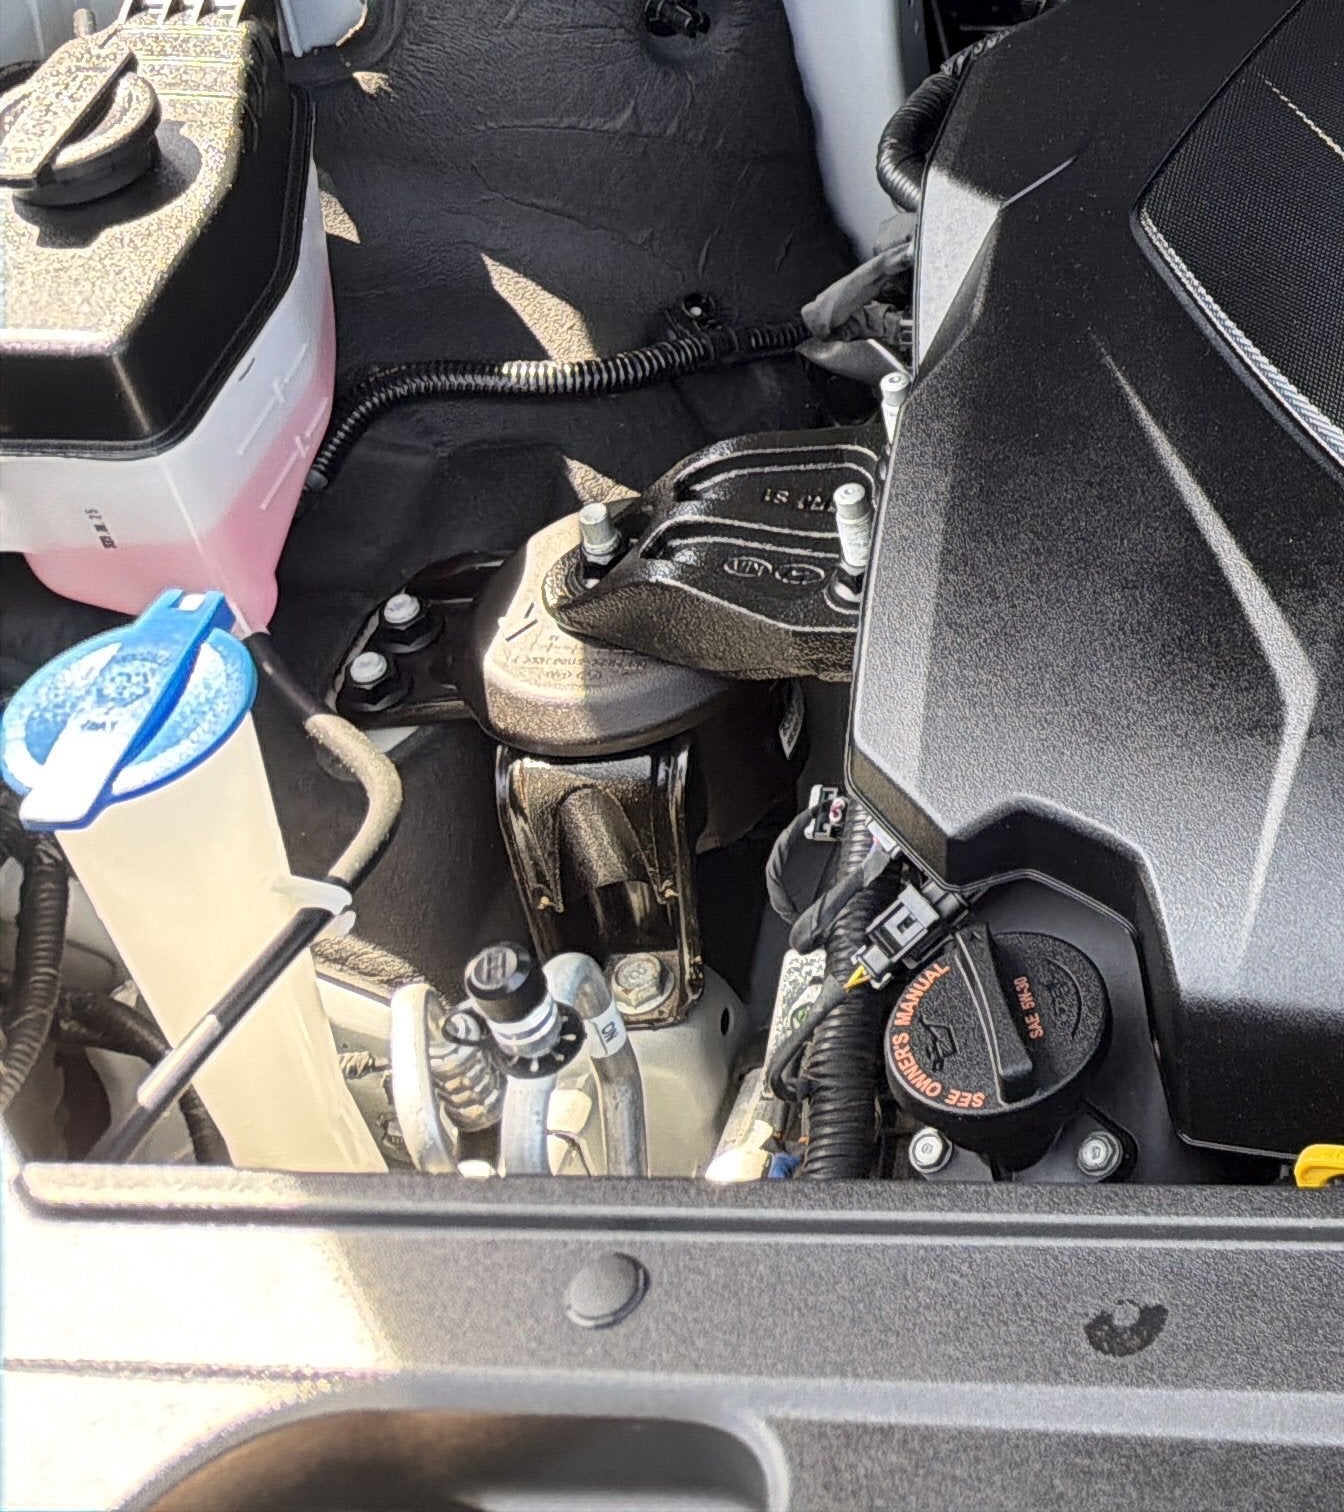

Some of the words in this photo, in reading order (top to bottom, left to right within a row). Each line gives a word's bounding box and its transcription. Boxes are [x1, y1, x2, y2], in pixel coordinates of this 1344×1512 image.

[894, 963, 950, 1026] MANUAL
[1013, 975, 1037, 1011] 5W-30
[1024, 1012, 1044, 1040] SAE
[891, 1031, 943, 1098] OWNER'S
[944, 1089, 986, 1108] SEE
